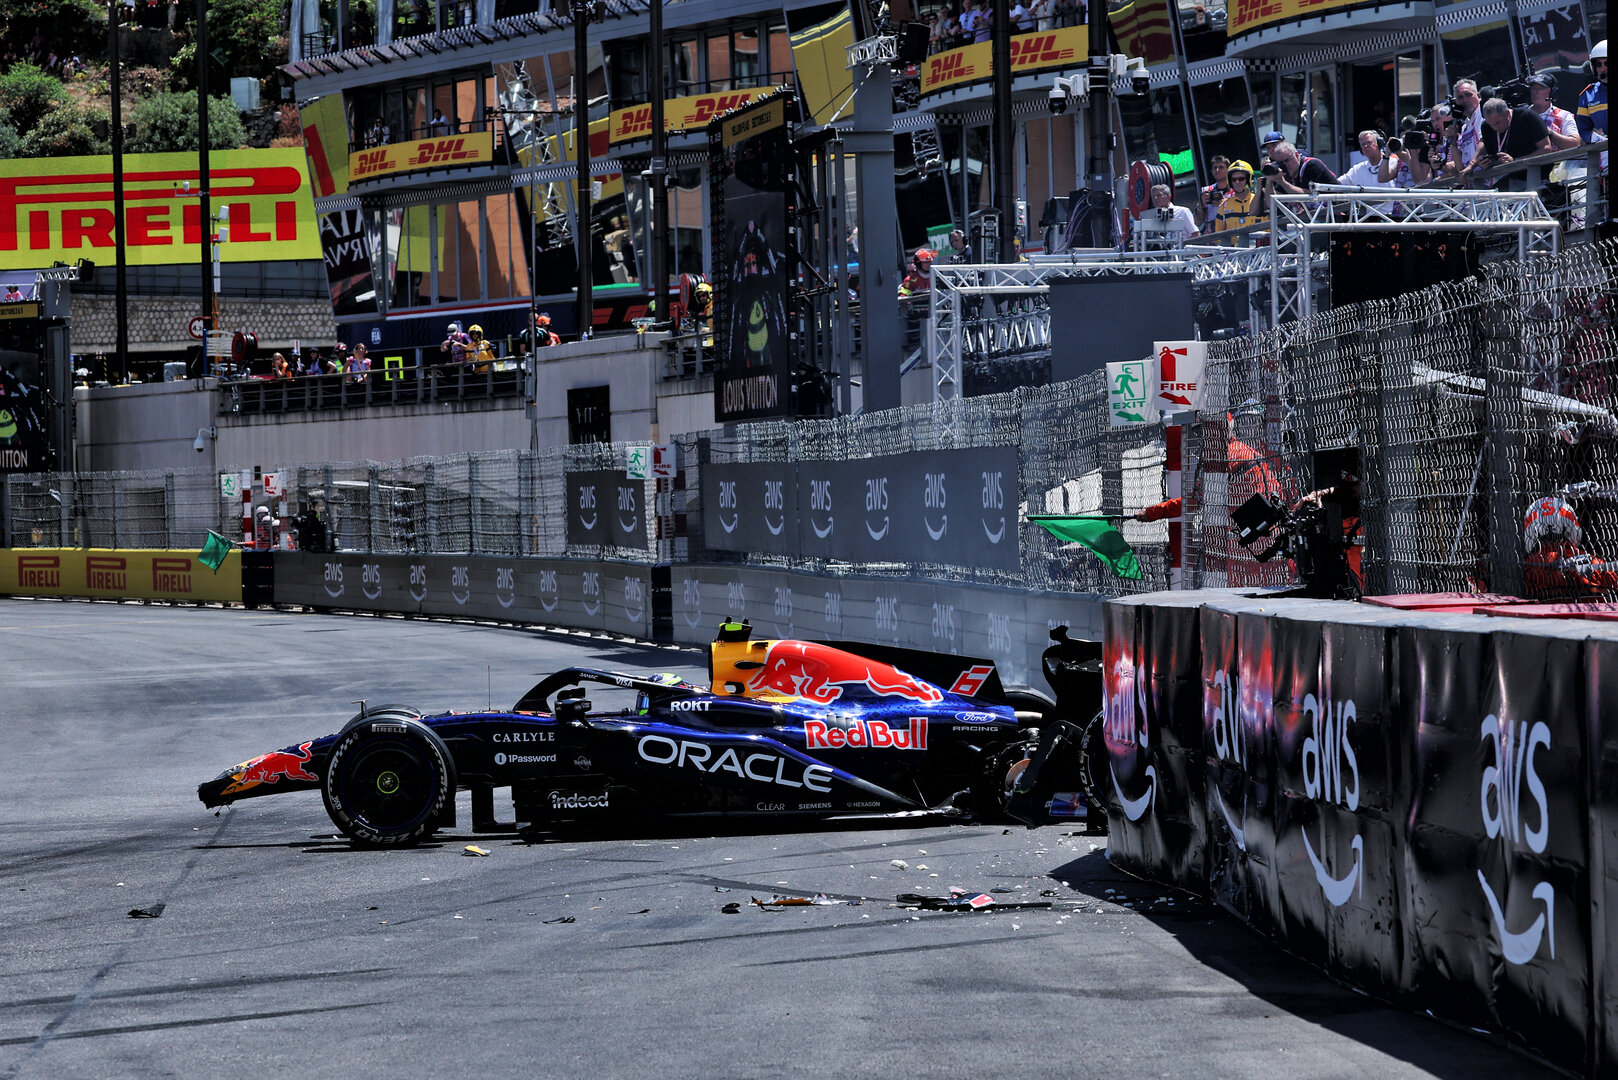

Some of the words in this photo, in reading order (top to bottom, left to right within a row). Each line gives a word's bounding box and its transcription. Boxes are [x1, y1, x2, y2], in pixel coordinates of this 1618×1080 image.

[931, 52, 966, 84] DHL
[621, 107, 652, 135] DH
[358, 149, 388, 175] DHL
[417, 138, 468, 164] DHL
[0, 166, 301, 250] PIRELLI
[723, 378, 745, 413] LOUIS
[745, 373, 778, 410] VUITTON
[1160, 383, 1197, 391] FIRE
[1112, 400, 1146, 409] EXIT
[0, 449, 28, 469] ITTON
[580, 485, 596, 509] aws
[617, 486, 635, 512] aws
[719, 481, 736, 509] aws
[764, 480, 783, 510] aws
[810, 479, 831, 512] aws
[865, 477, 888, 512] aws
[924, 472, 946, 509] aws
[982, 471, 1003, 510] aws
[18, 556, 60, 587] PIRELLI
[86, 556, 126, 590] PIRELLI
[152, 558, 192, 592] PIRELLI
[324, 562, 343, 582] aws
[362, 564, 380, 584] aws
[410, 564, 426, 585] aws
[452, 566, 469, 587] aws
[496, 567, 514, 589] aws
[540, 570, 557, 593] aws
[582, 571, 599, 596] aws
[624, 575, 642, 602] aws
[683, 578, 700, 606] aws
[727, 581, 745, 611] aws
[774, 587, 792, 617] aws
[825, 591, 841, 623] aw
[875, 596, 897, 631] aws
[931, 602, 955, 641] aws
[988, 612, 1011, 653] aws
[615, 678, 633, 687] VISA
[948, 665, 995, 697] 6
[670, 700, 712, 712] ROKT
[963, 712, 988, 722] Ford
[1112, 660, 1149, 748] aws
[371, 723, 407, 733] PIRELLI
[804, 719, 868, 749] Red
[866, 716, 928, 750] Bull
[1213, 669, 1247, 772] aw
[492, 732, 555, 743] CARLYLE
[508, 754, 557, 763] 1Password
[638, 734, 834, 793] ORACLE
[1302, 693, 1359, 811] aws
[1481, 714, 1551, 853] aws
[551, 791, 609, 809] indeed
[756, 802, 785, 811] CLEAR
[798, 802, 832, 810] SIEMENS
